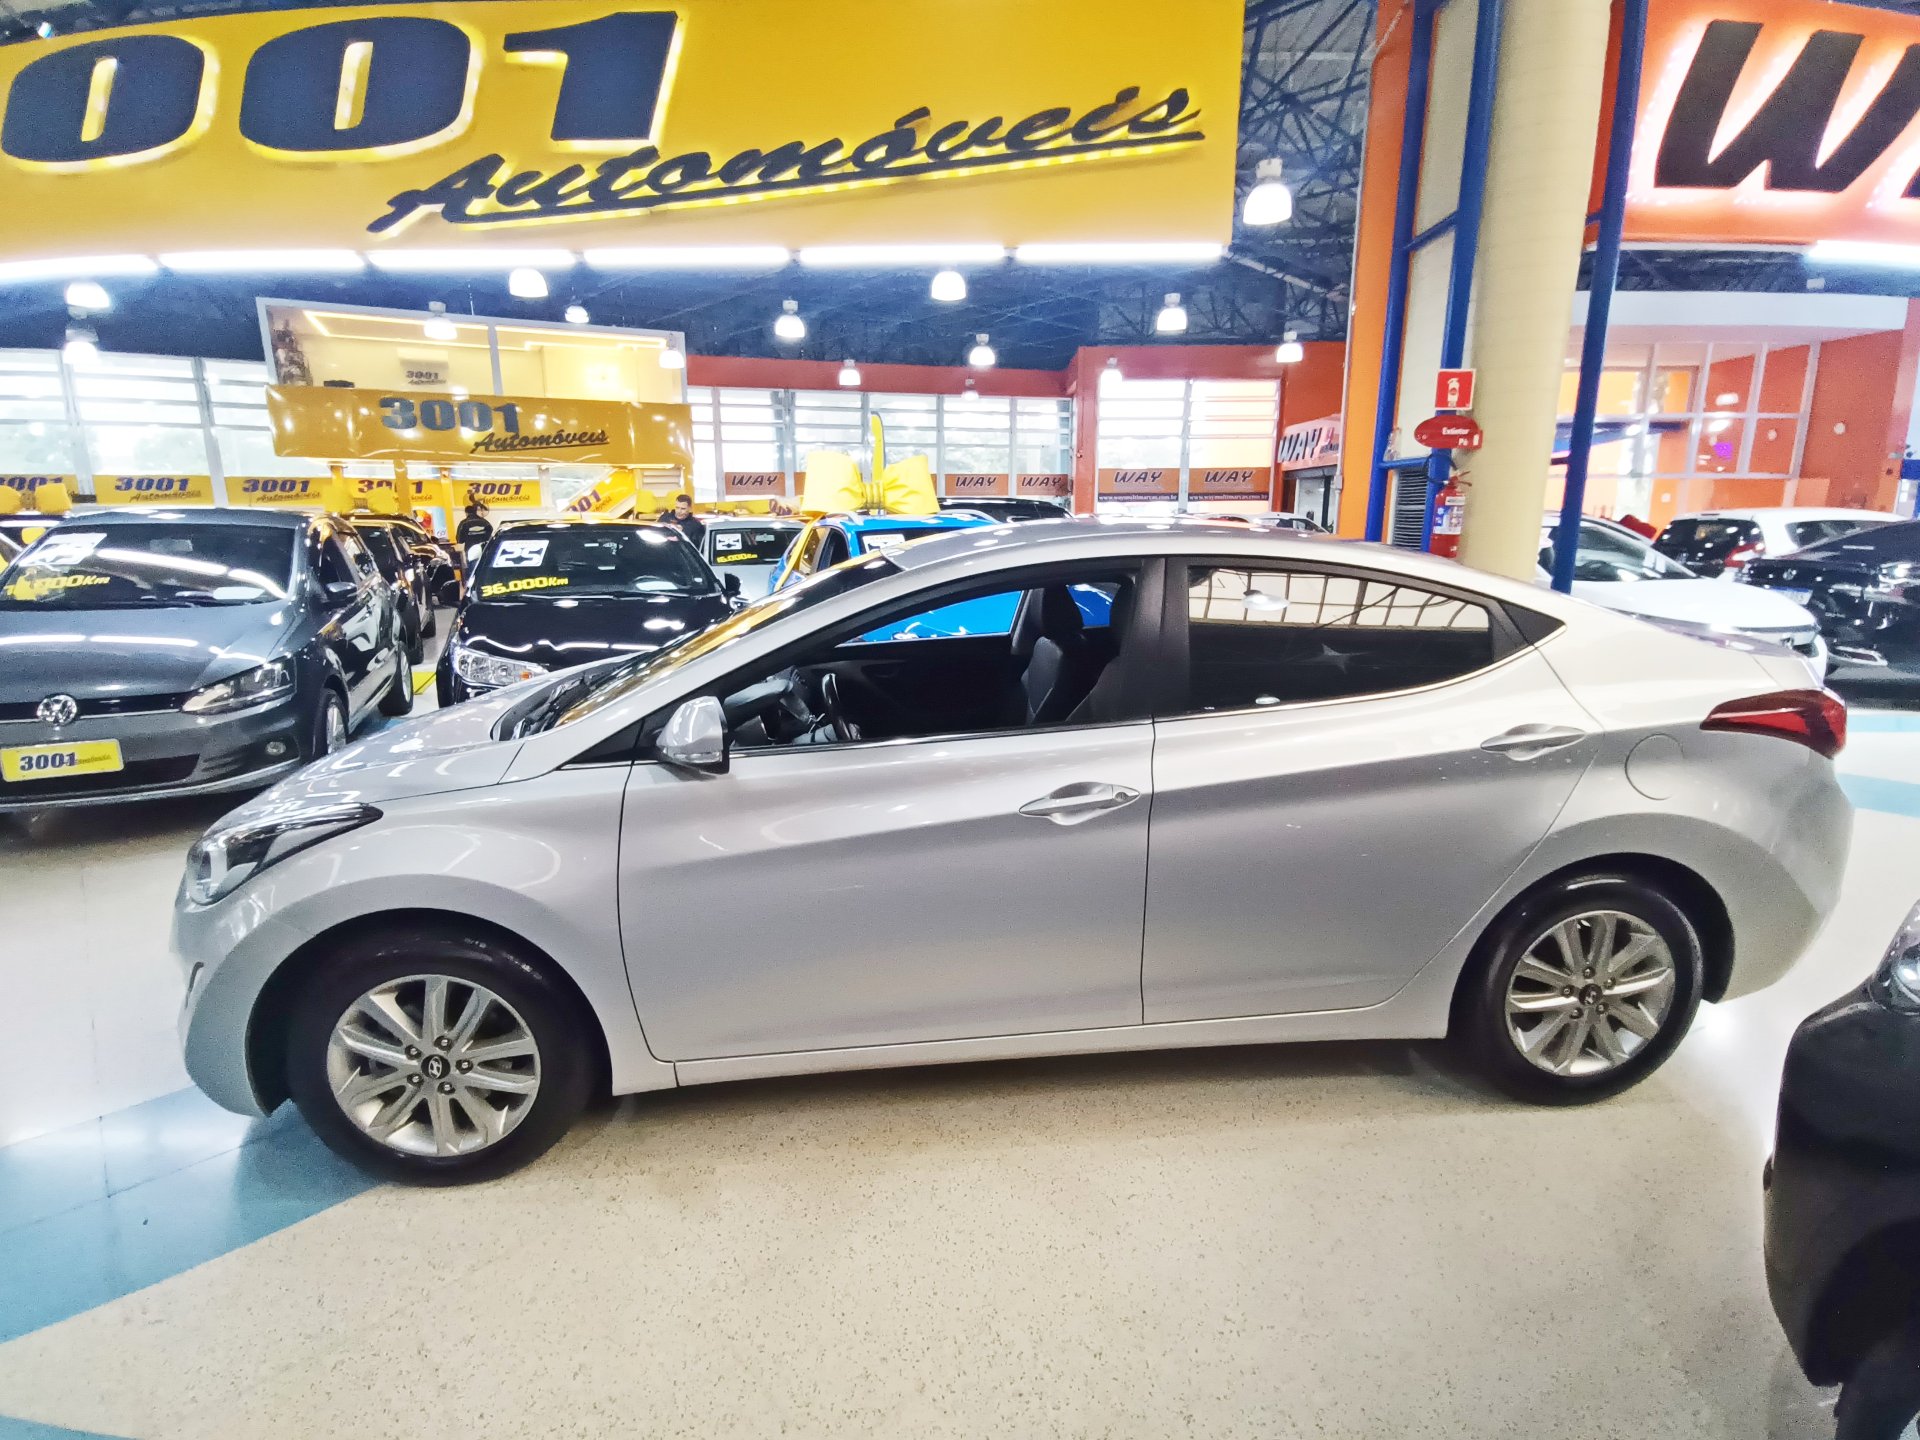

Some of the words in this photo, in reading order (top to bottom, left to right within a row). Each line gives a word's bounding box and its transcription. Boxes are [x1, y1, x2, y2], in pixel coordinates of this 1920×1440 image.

[1654, 19, 1920, 199] W
[366, 87, 1206, 233] Automóveis
[379, 397, 519, 434] 3001
[470, 429, 610, 453] Automóveis
[1279, 427, 1322, 463] WAY
[115, 477, 189, 491] 3001
[731, 475, 778, 486] WAY
[955, 476, 996, 486] WAY
[1021, 476, 1061, 486] WAY
[1114, 472, 1162, 482] WAY
[1204, 471, 1253, 482] WAY
[242, 479, 310, 492] 3001
[481, 577, 568, 597] 36.000Km
[20, 752, 76, 771] 3001
